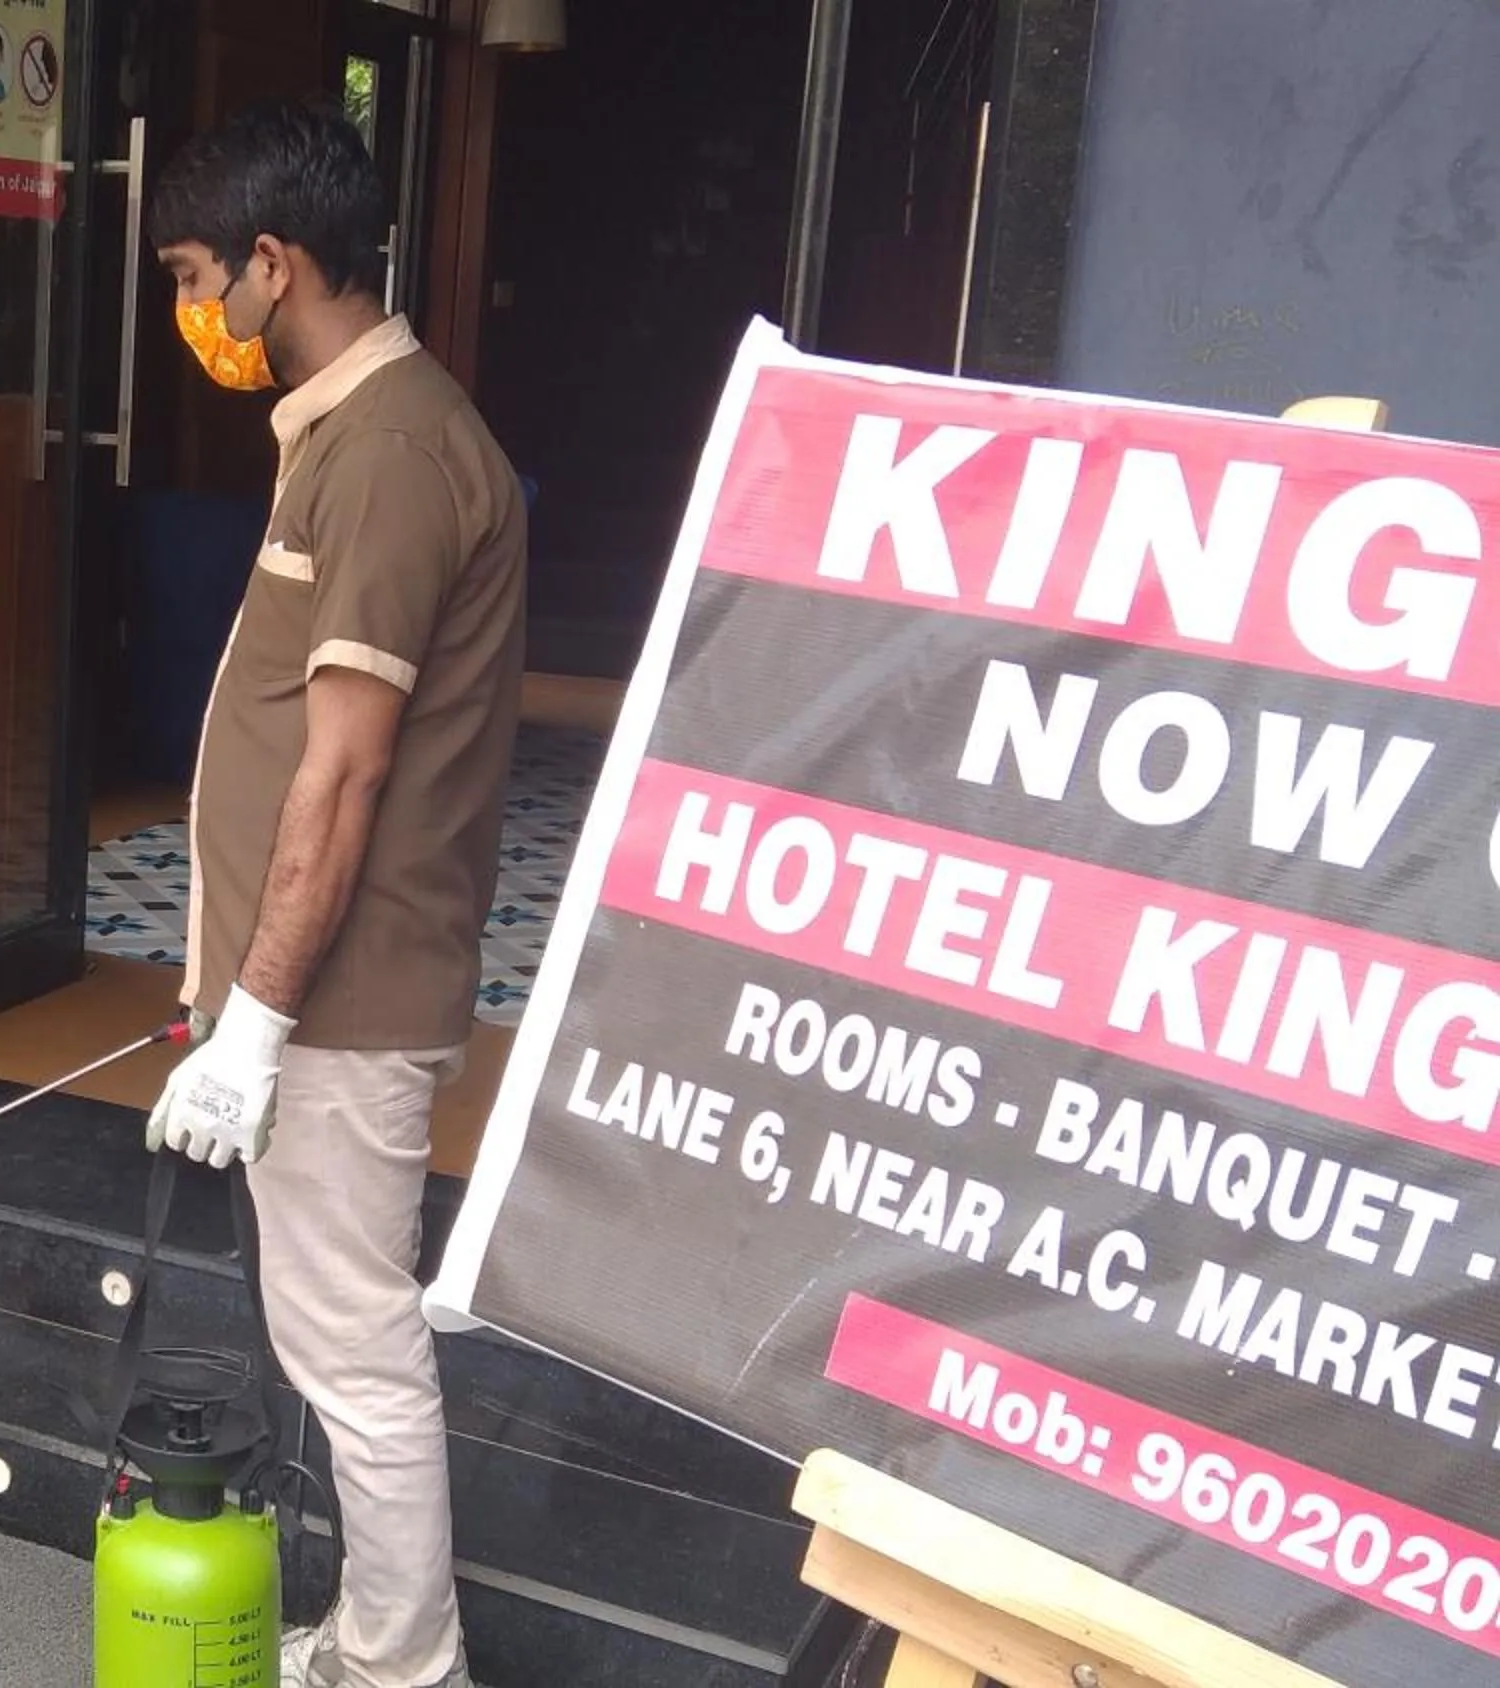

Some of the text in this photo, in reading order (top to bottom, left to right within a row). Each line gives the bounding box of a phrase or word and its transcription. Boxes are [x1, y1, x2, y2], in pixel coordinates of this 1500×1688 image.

[8, 173, 21, 192] of
[816, 412, 1482, 682] KING
[956, 659, 1437, 870] NOW
[654, 790, 1500, 1133] HOTEL KING
[565, 1048, 733, 1164] LANE
[740, 1120, 791, 1204] 6,
[810, 1130, 1006, 1262] NEAR
[1006, 1207, 1157, 1324] A.C.
[724, 983, 982, 1129] ROOMS
[1035, 1078, 1459, 1277] BANQUET
[162, 1615, 190, 1628] FILL
[927, 1347, 1500, 1632] Mob: 9602020
